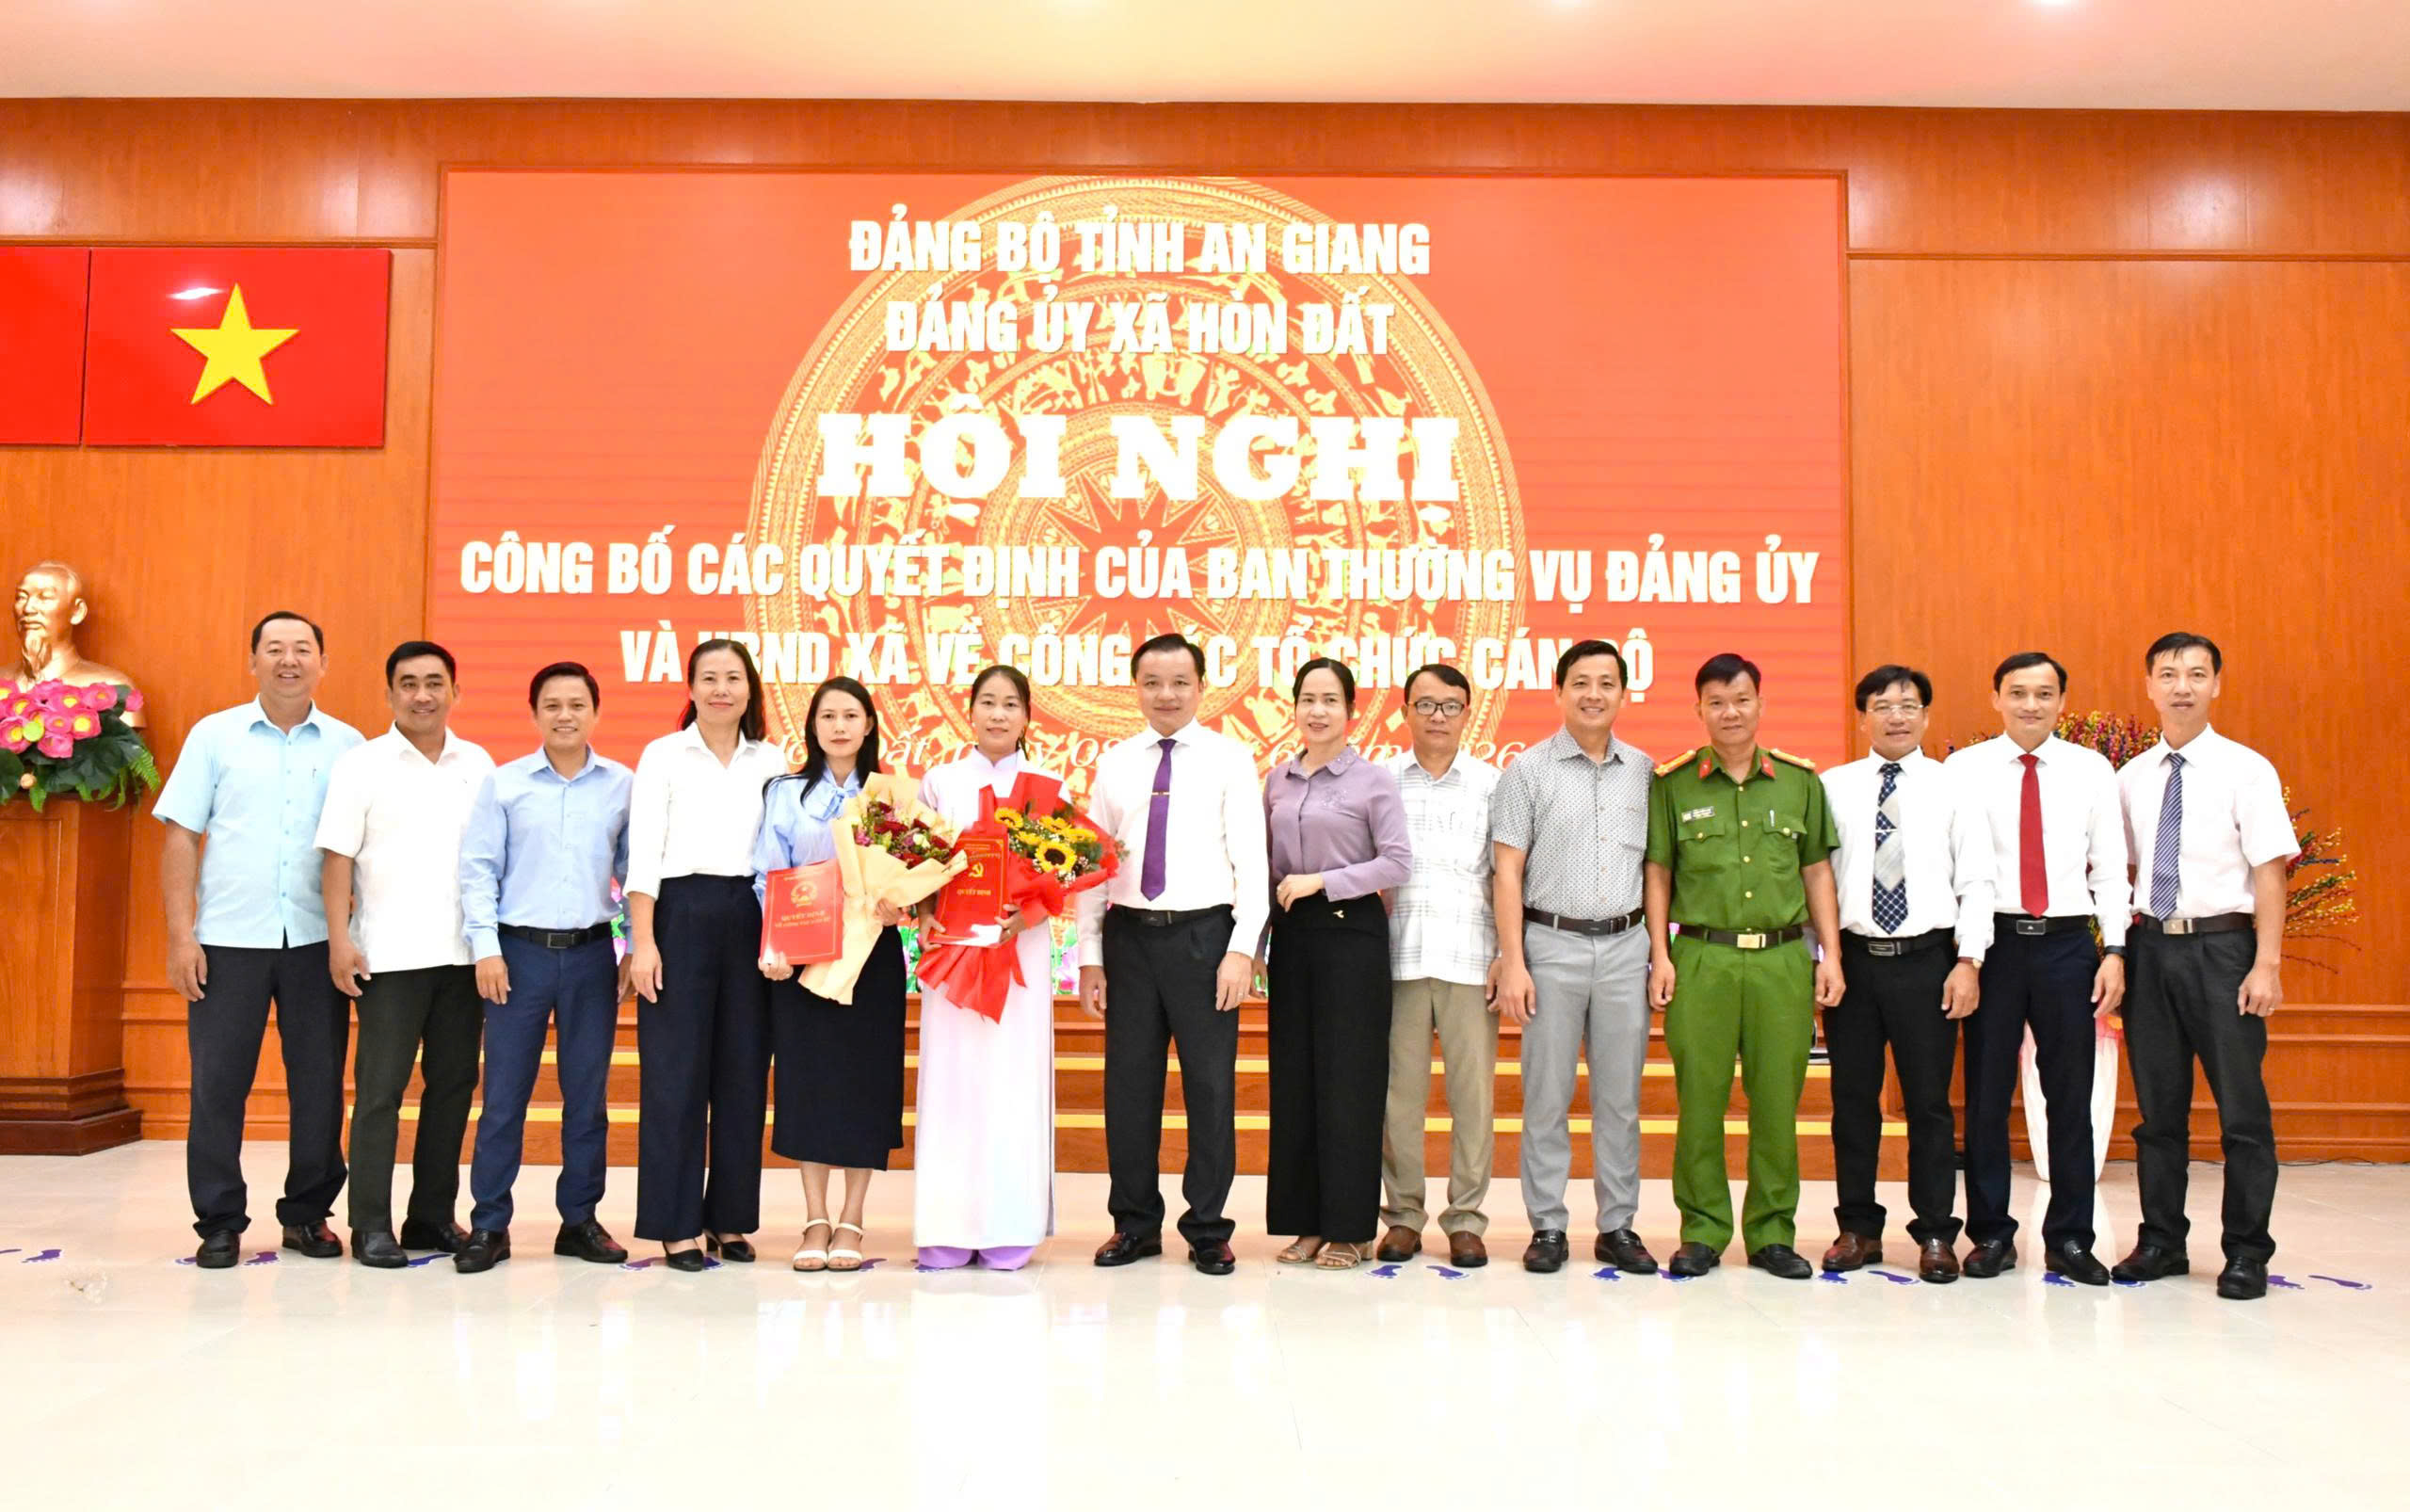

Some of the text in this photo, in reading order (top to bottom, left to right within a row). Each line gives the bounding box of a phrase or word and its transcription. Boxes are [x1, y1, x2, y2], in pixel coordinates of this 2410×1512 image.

[848, 203, 1430, 282] ĐẢNG BỘ TỈNH AN GIANG
[885, 283, 1395, 354] ĐẢNG ỦY XÃ HÒN ĐẤT
[817, 393, 1459, 523] HỘI NGHỊ
[460, 524, 1820, 614] CÔNG BỐ CÁC QUYẾT ĐỊNH CỦA BAN THƯỜNG VỤ ĐẢNG ỦY
[620, 619, 683, 683] VÀ
[845, 622, 911, 684] XÃ
[925, 617, 983, 685] VỀ
[999, 622, 1131, 686] CÔNG
[1251, 616, 1311, 688] TỔ
[1472, 627, 1573, 689] CÁN
[1614, 628, 1653, 702] Ộ
